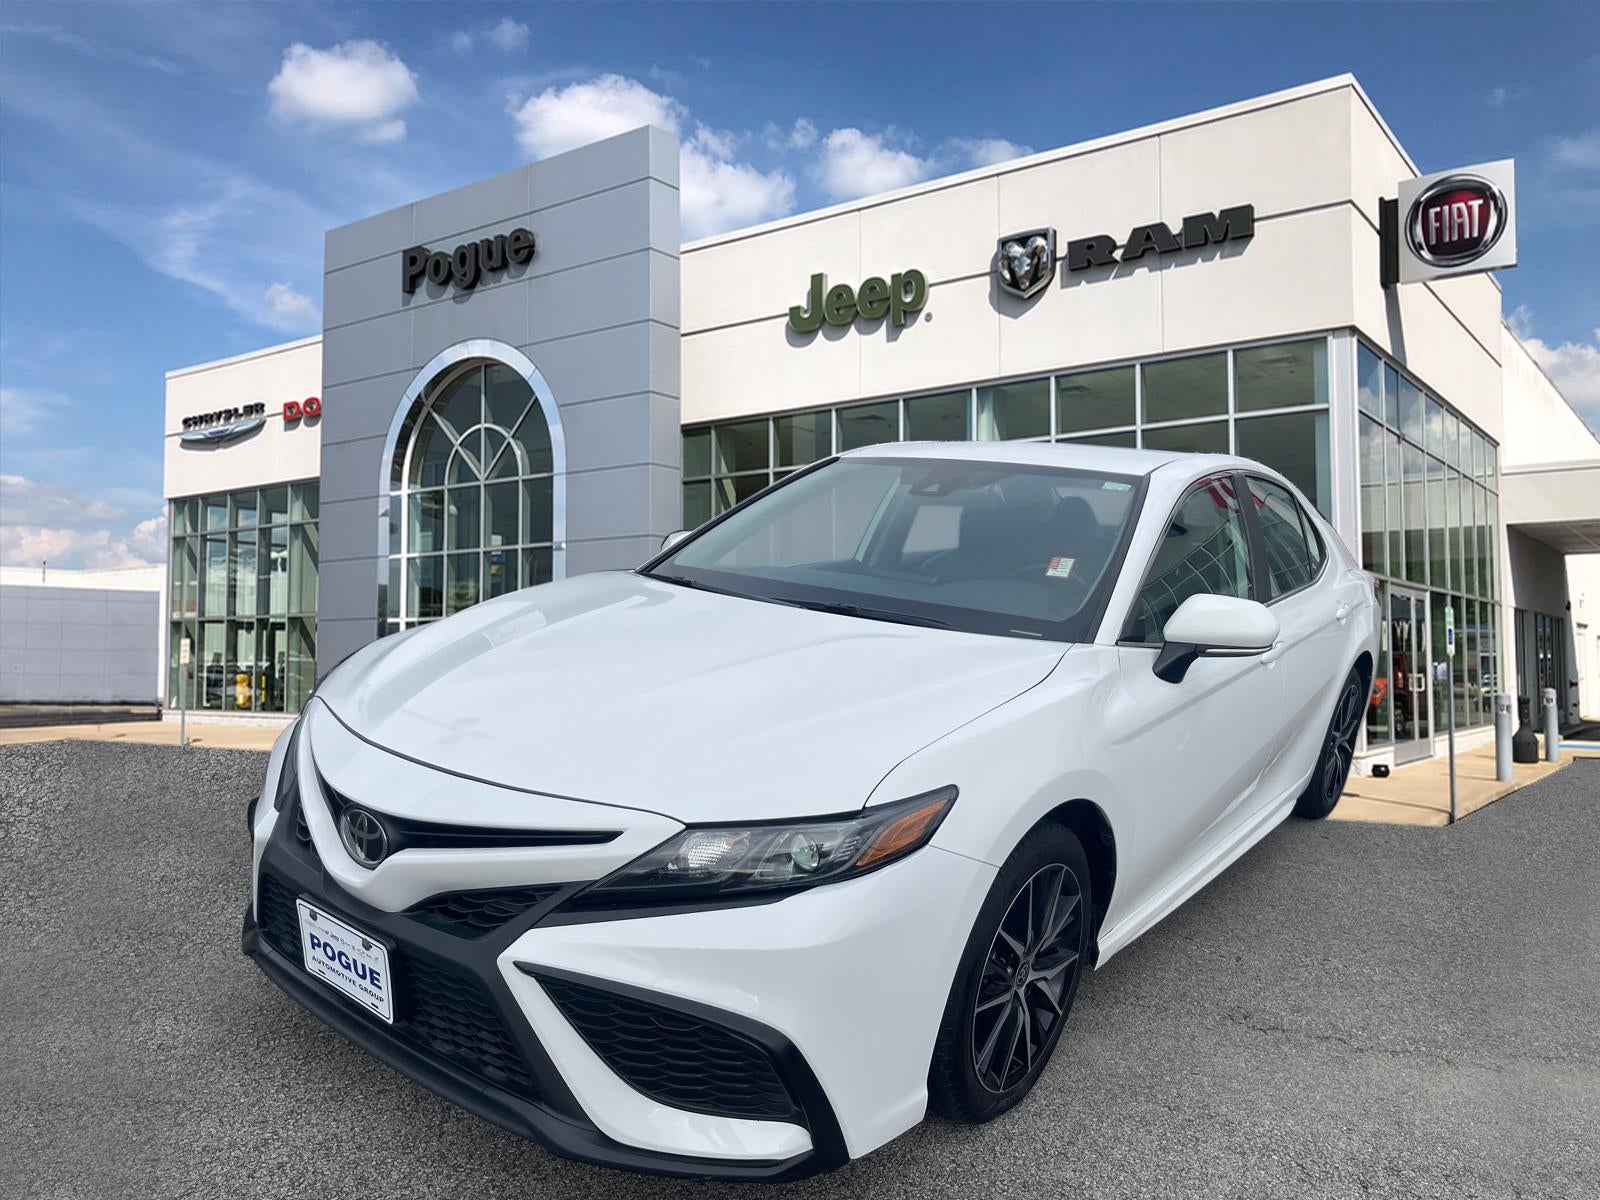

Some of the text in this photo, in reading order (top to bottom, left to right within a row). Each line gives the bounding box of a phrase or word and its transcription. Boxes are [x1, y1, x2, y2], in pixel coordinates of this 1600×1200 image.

[1067, 203, 1255, 272] RAM
[1428, 199, 1484, 246] FIAT
[402, 227, 536, 294] Pogue
[788, 268, 929, 333] Jeep
[182, 402, 265, 429] CHRYSLER
[309, 932, 383, 991] POGUE
[312, 955, 385, 1003] AUTOMOTIVE GROUP
